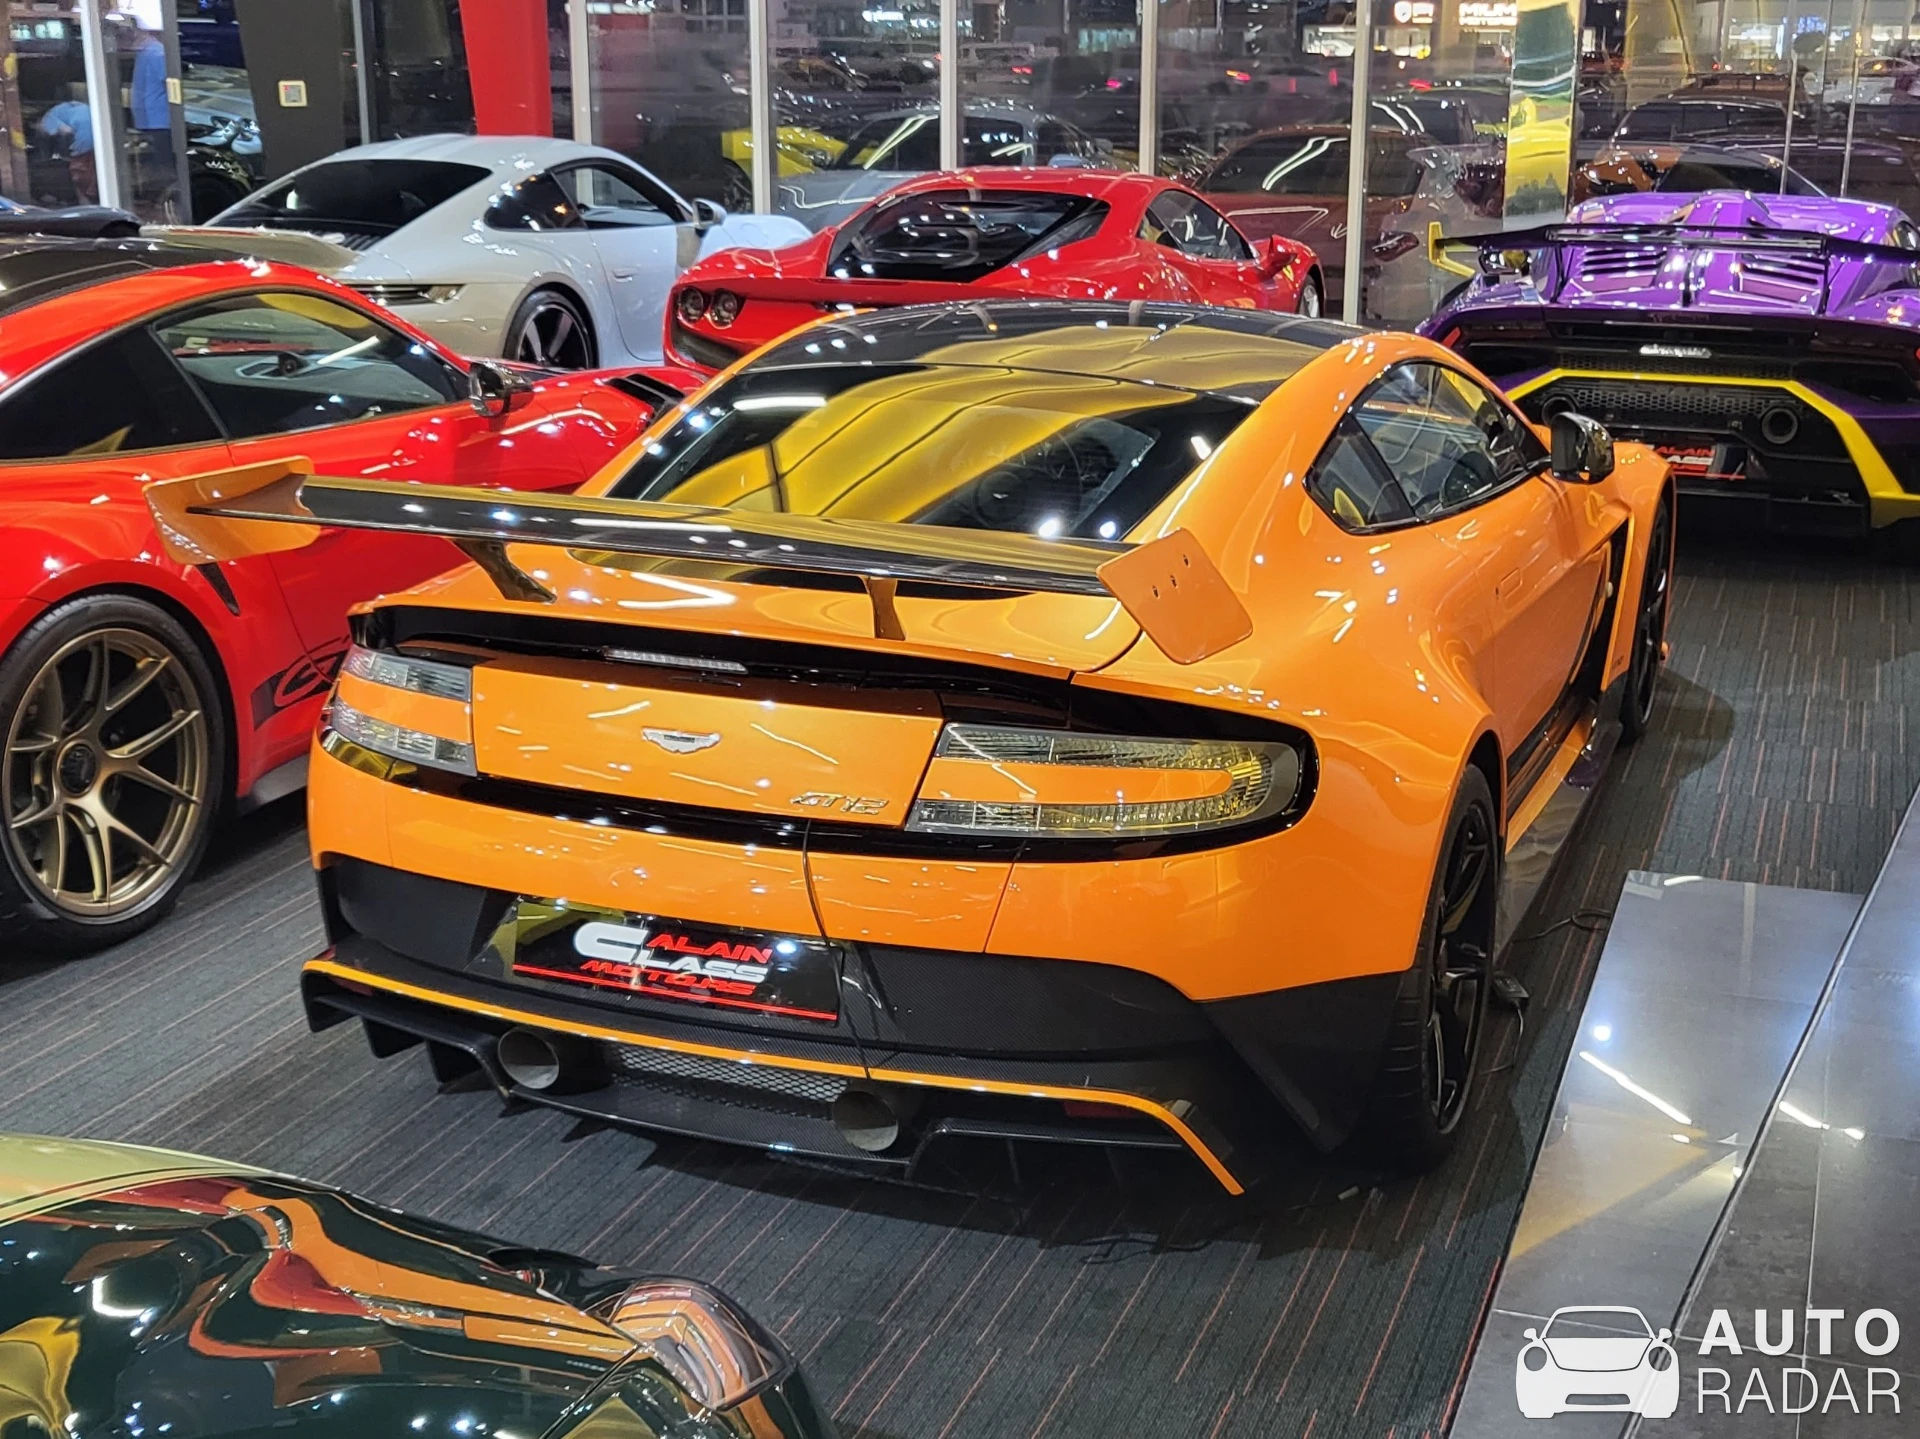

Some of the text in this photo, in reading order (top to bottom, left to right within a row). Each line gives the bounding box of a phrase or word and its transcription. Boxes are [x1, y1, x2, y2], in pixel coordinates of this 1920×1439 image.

[573, 921, 769, 984] CLASS
[646, 933, 773, 964] ALAIN
[580, 959, 757, 996] MOTORS
